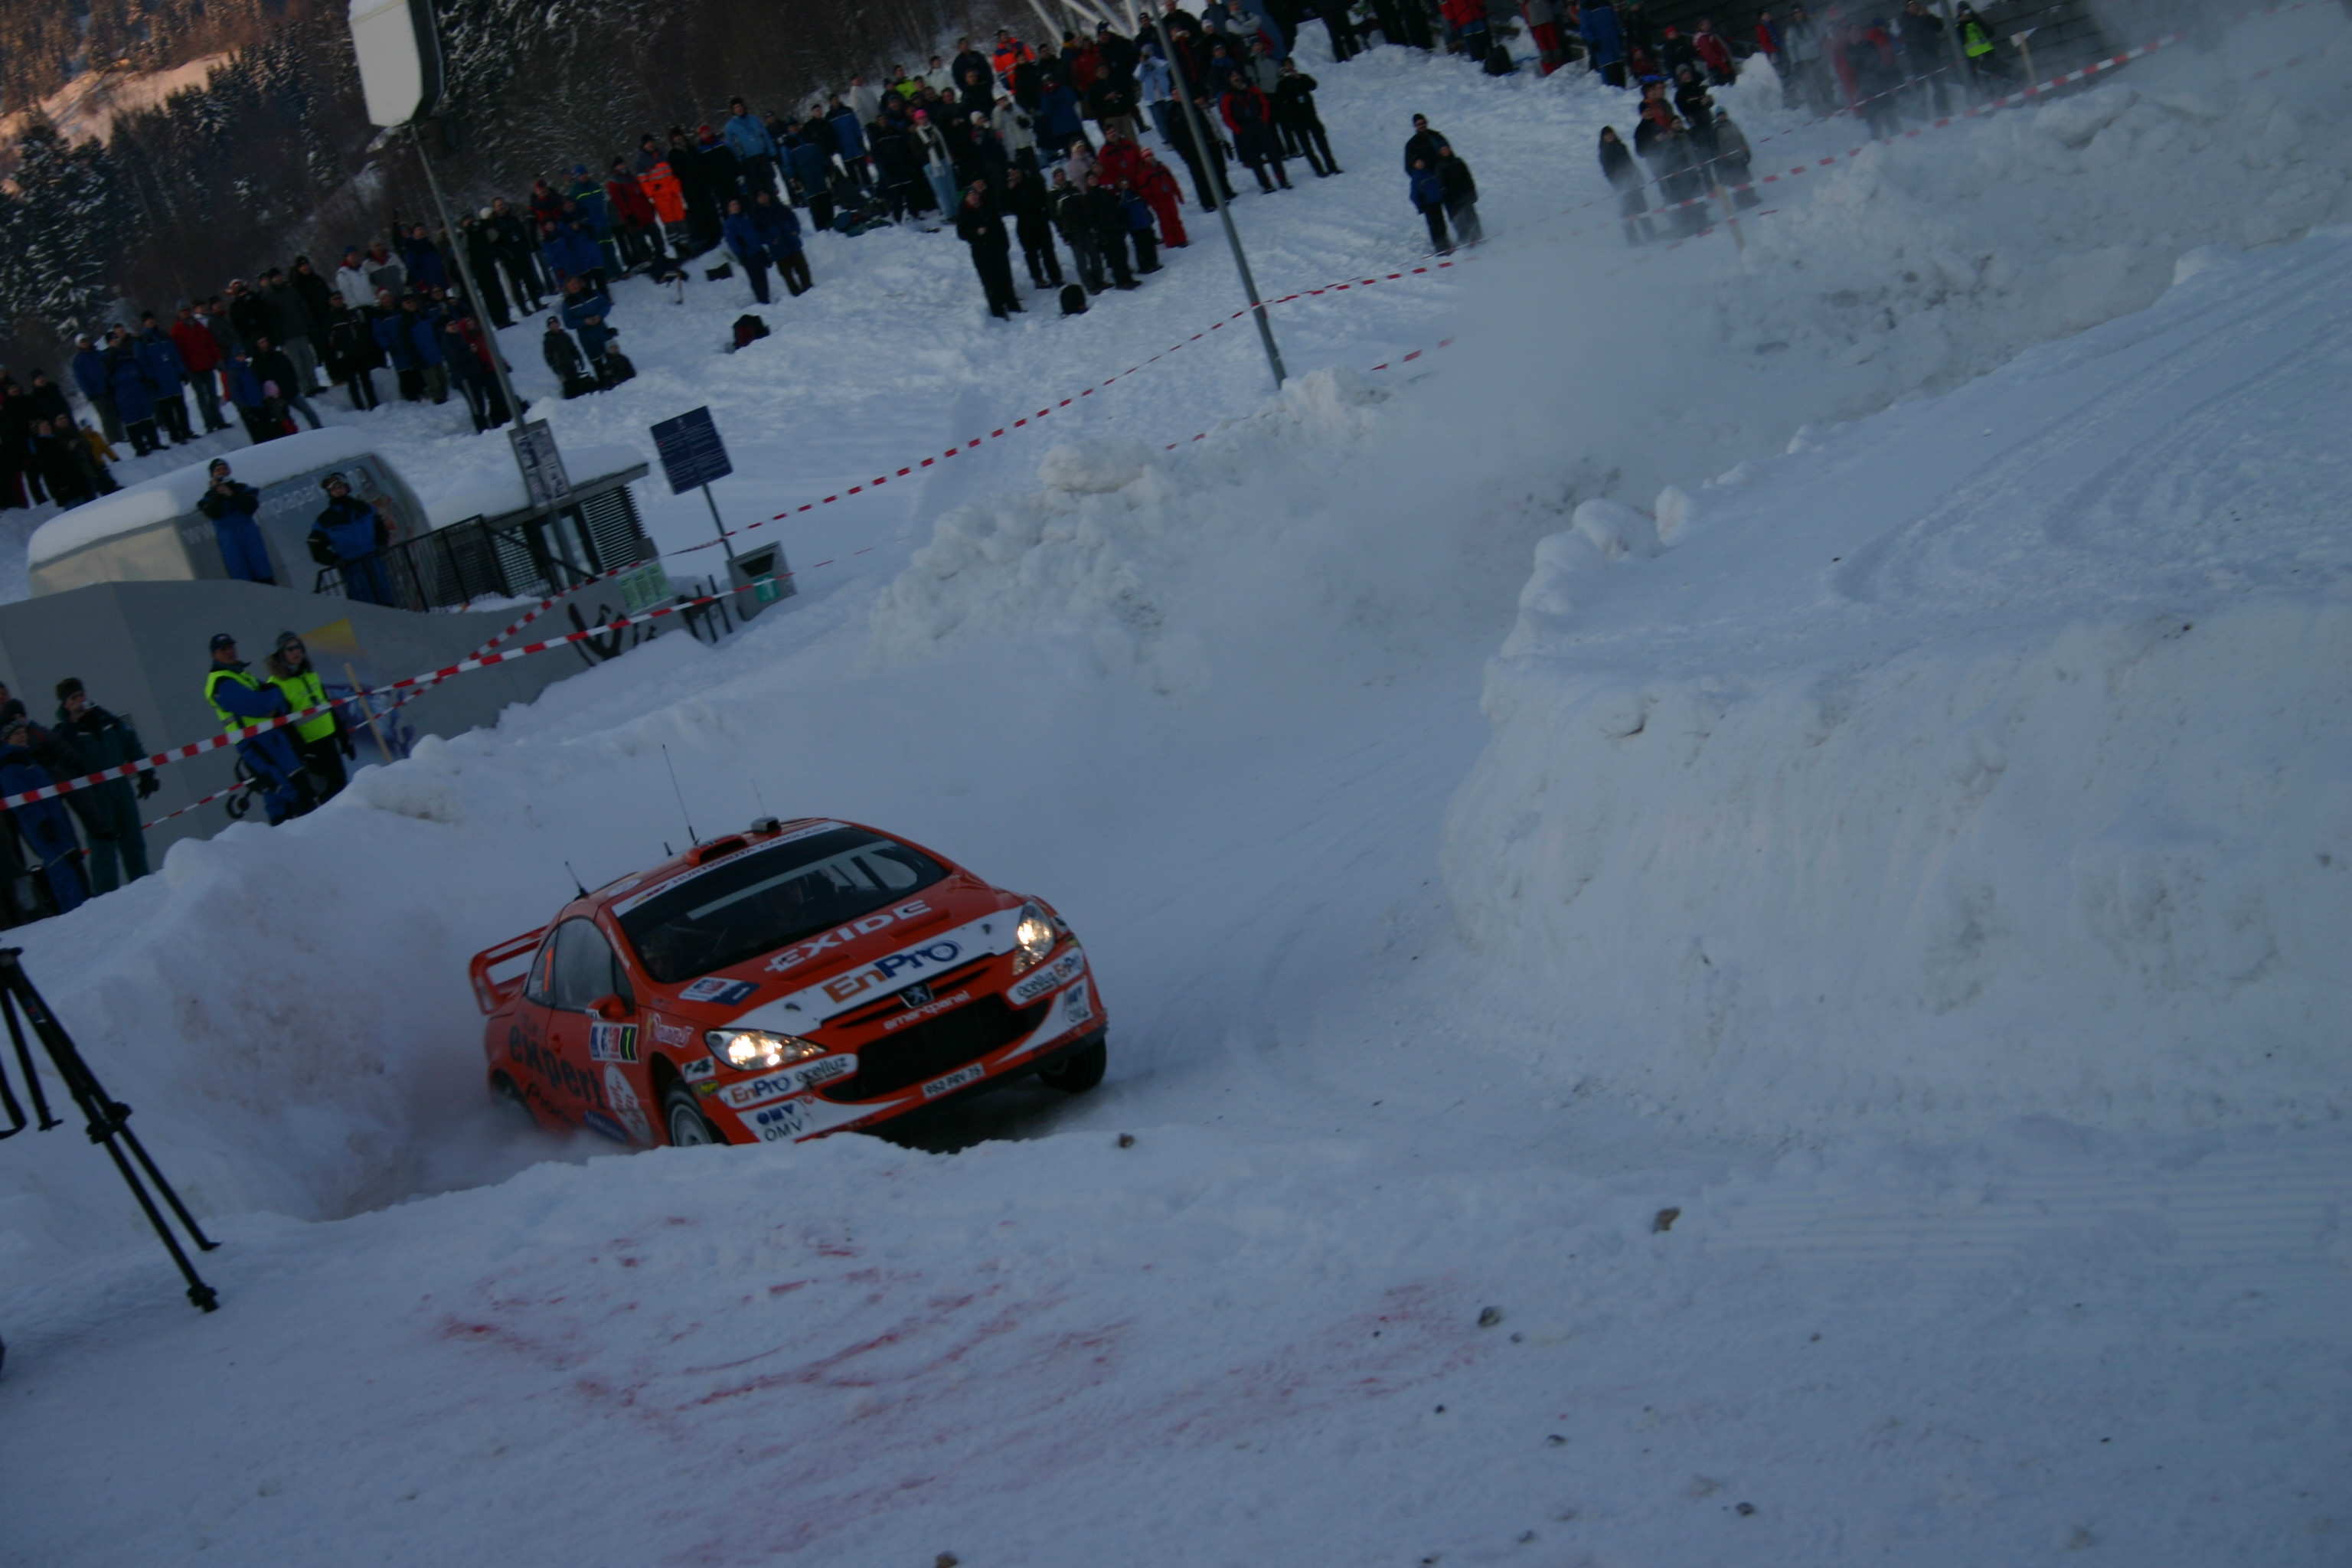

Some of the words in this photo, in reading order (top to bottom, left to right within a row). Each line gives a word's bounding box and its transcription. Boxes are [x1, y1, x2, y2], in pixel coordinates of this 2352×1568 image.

[765, 900, 932, 972] EXIDE
[821, 942, 962, 1004] EnPro
[508, 1024, 604, 1111] expert
[730, 1076, 791, 1104] EnPro
[766, 1118, 802, 1142] OMV
